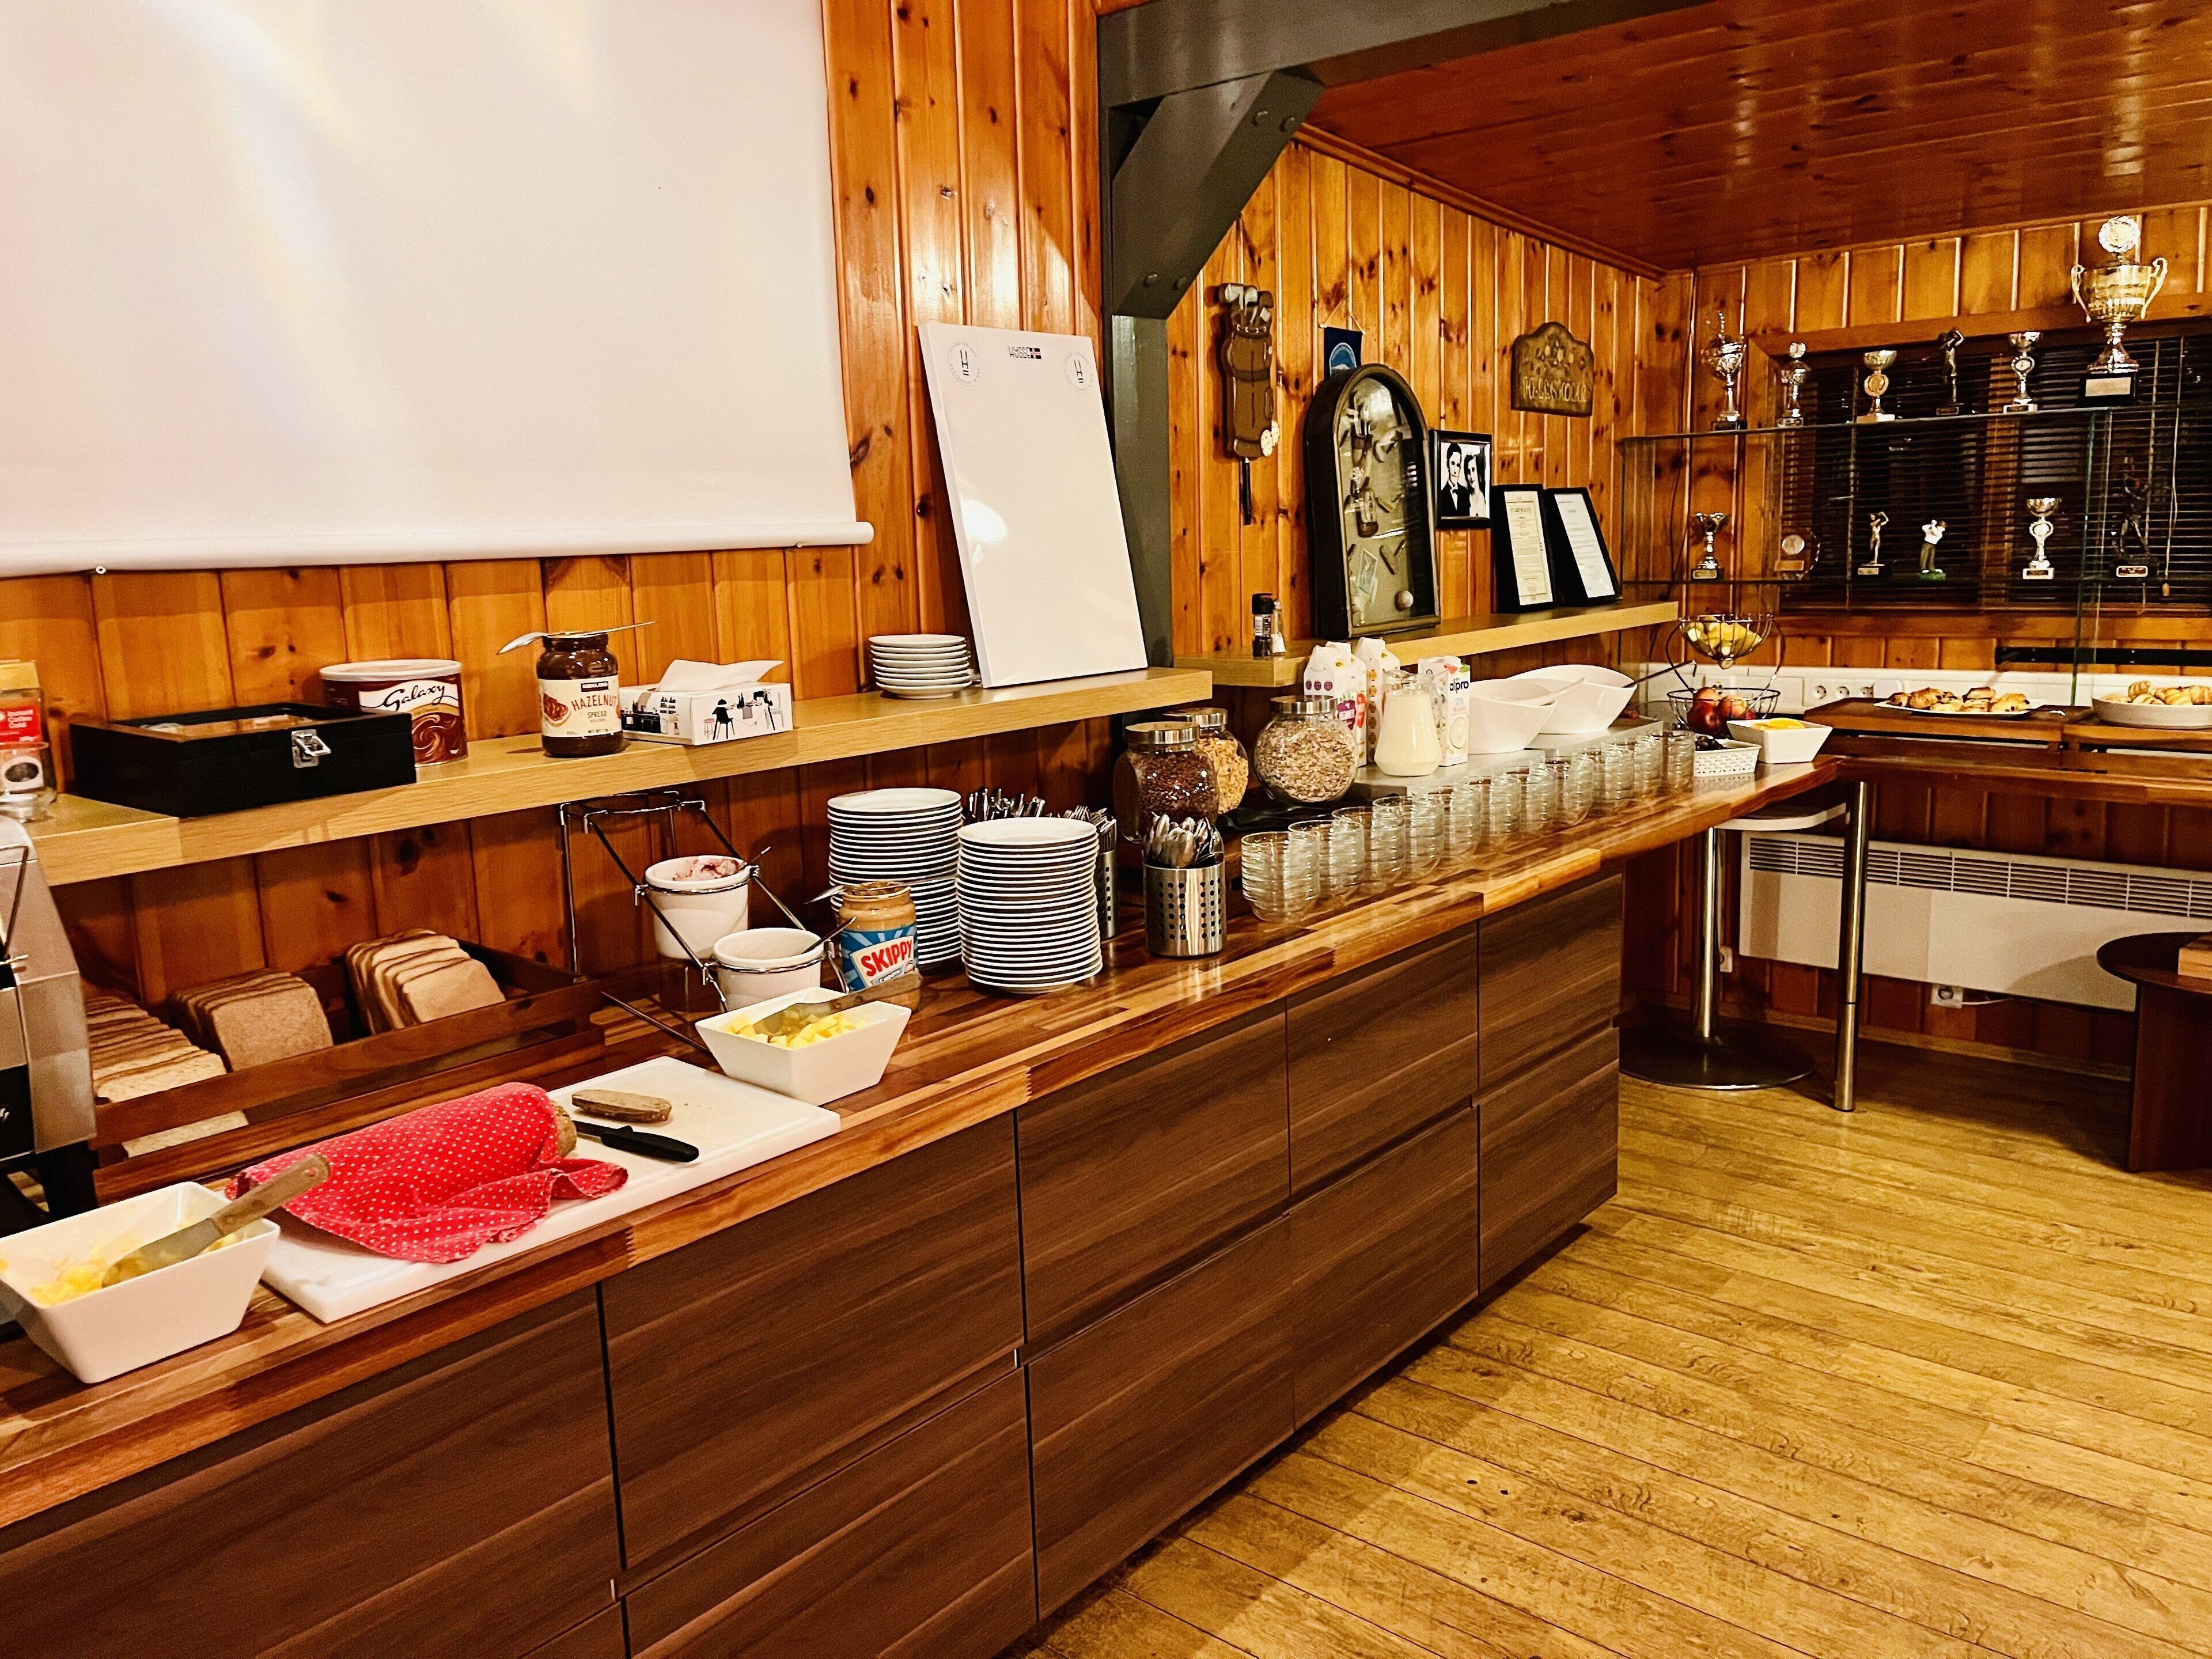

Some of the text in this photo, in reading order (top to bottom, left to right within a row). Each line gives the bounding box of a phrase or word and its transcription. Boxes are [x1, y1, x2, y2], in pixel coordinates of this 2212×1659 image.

[1449, 678, 1469, 694] alpro
[374, 684, 452, 711] Galaxy
[571, 695, 618, 711] HAZELNUT
[587, 710, 607, 718] SPREAD
[861, 940, 912, 977] SKIPPY
